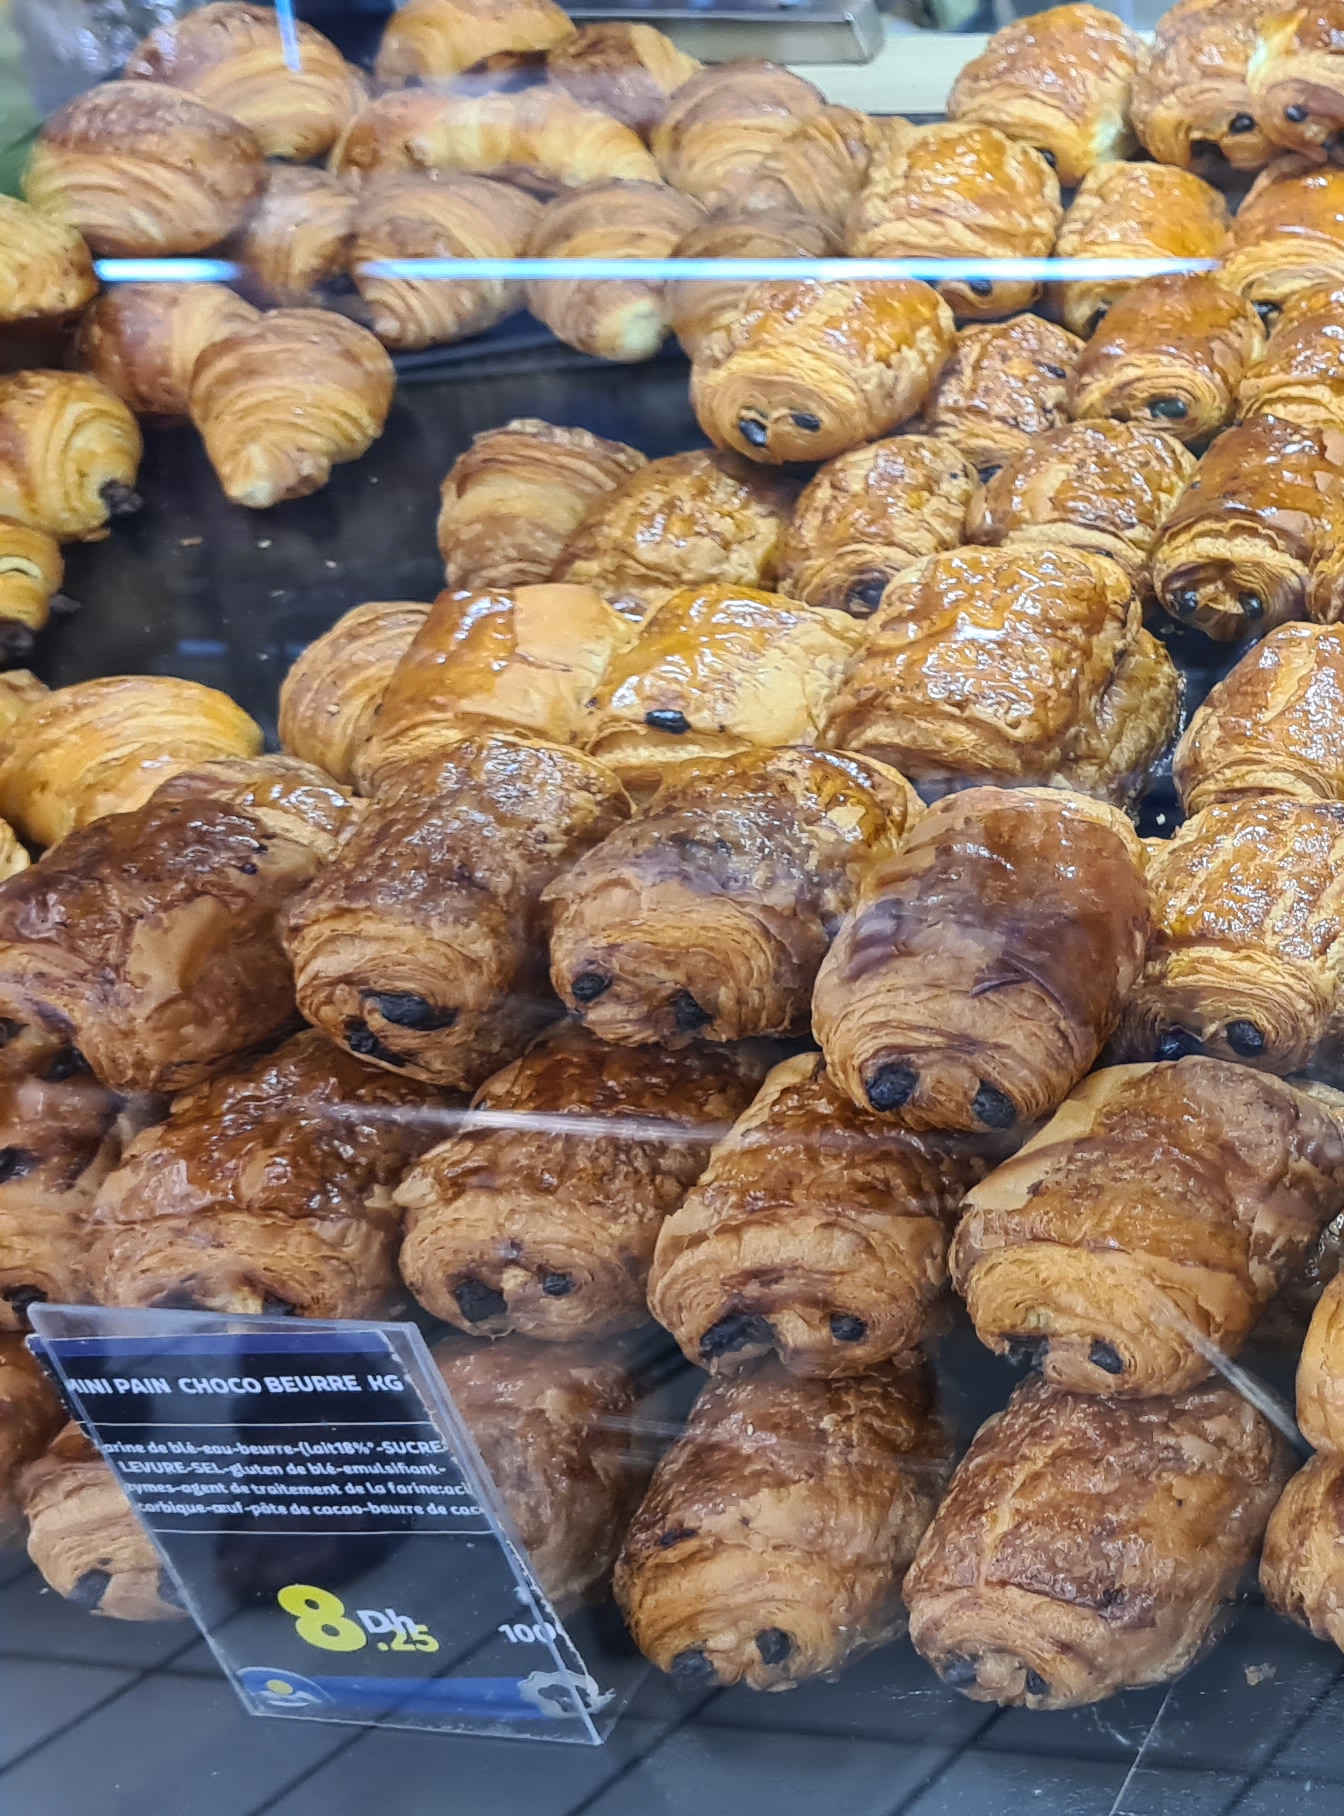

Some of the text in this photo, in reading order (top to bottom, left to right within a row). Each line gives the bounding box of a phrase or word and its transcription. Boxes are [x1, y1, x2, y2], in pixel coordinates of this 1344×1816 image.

[66, 1375, 404, 1394] MINI PAIN CHOCO BEURRE KG
[103, 1441, 146, 1454] arine
[147, 1441, 166, 1454] de
[118, 1461, 446, 1478] LEVURE-SEL-gluten de blé-emulsifiant-
[230, 1482, 250, 1494] de
[250, 1482, 342, 1495] traitement
[344, 1482, 364, 1495] de
[365, 1482, 386, 1495] la
[135, 1501, 484, 1519] corbique-œuf-pâte de cacao-beurre de cac
[277, 1584, 367, 1652] 8
[356, 1608, 417, 1634] Dh
[498, 1622, 562, 1643] 100
